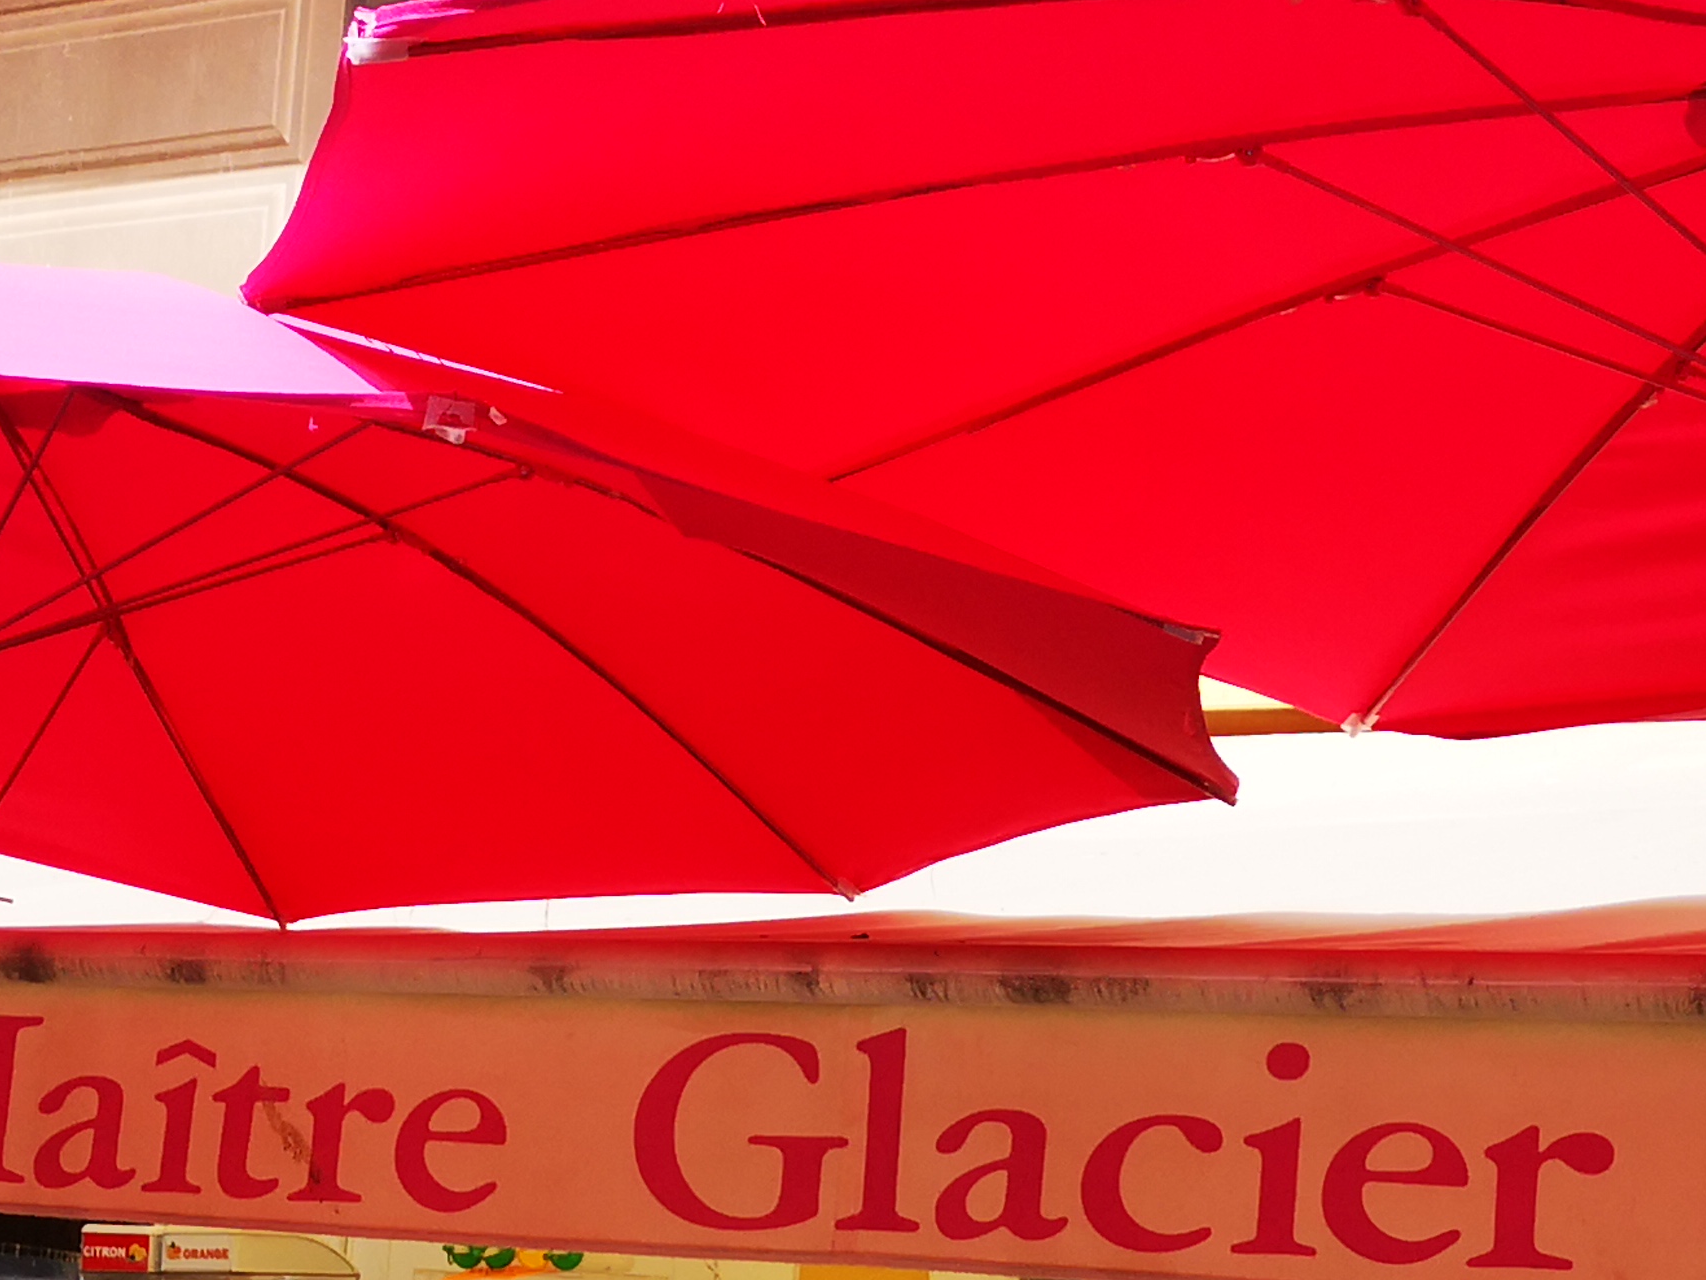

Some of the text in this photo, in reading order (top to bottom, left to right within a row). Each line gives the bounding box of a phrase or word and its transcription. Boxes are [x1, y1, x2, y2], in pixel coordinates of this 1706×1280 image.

[632, 1027, 1615, 1271] Glacier
[83, 1246, 126, 1258] CITRON
[183, 1248, 229, 1260] ORANGE
